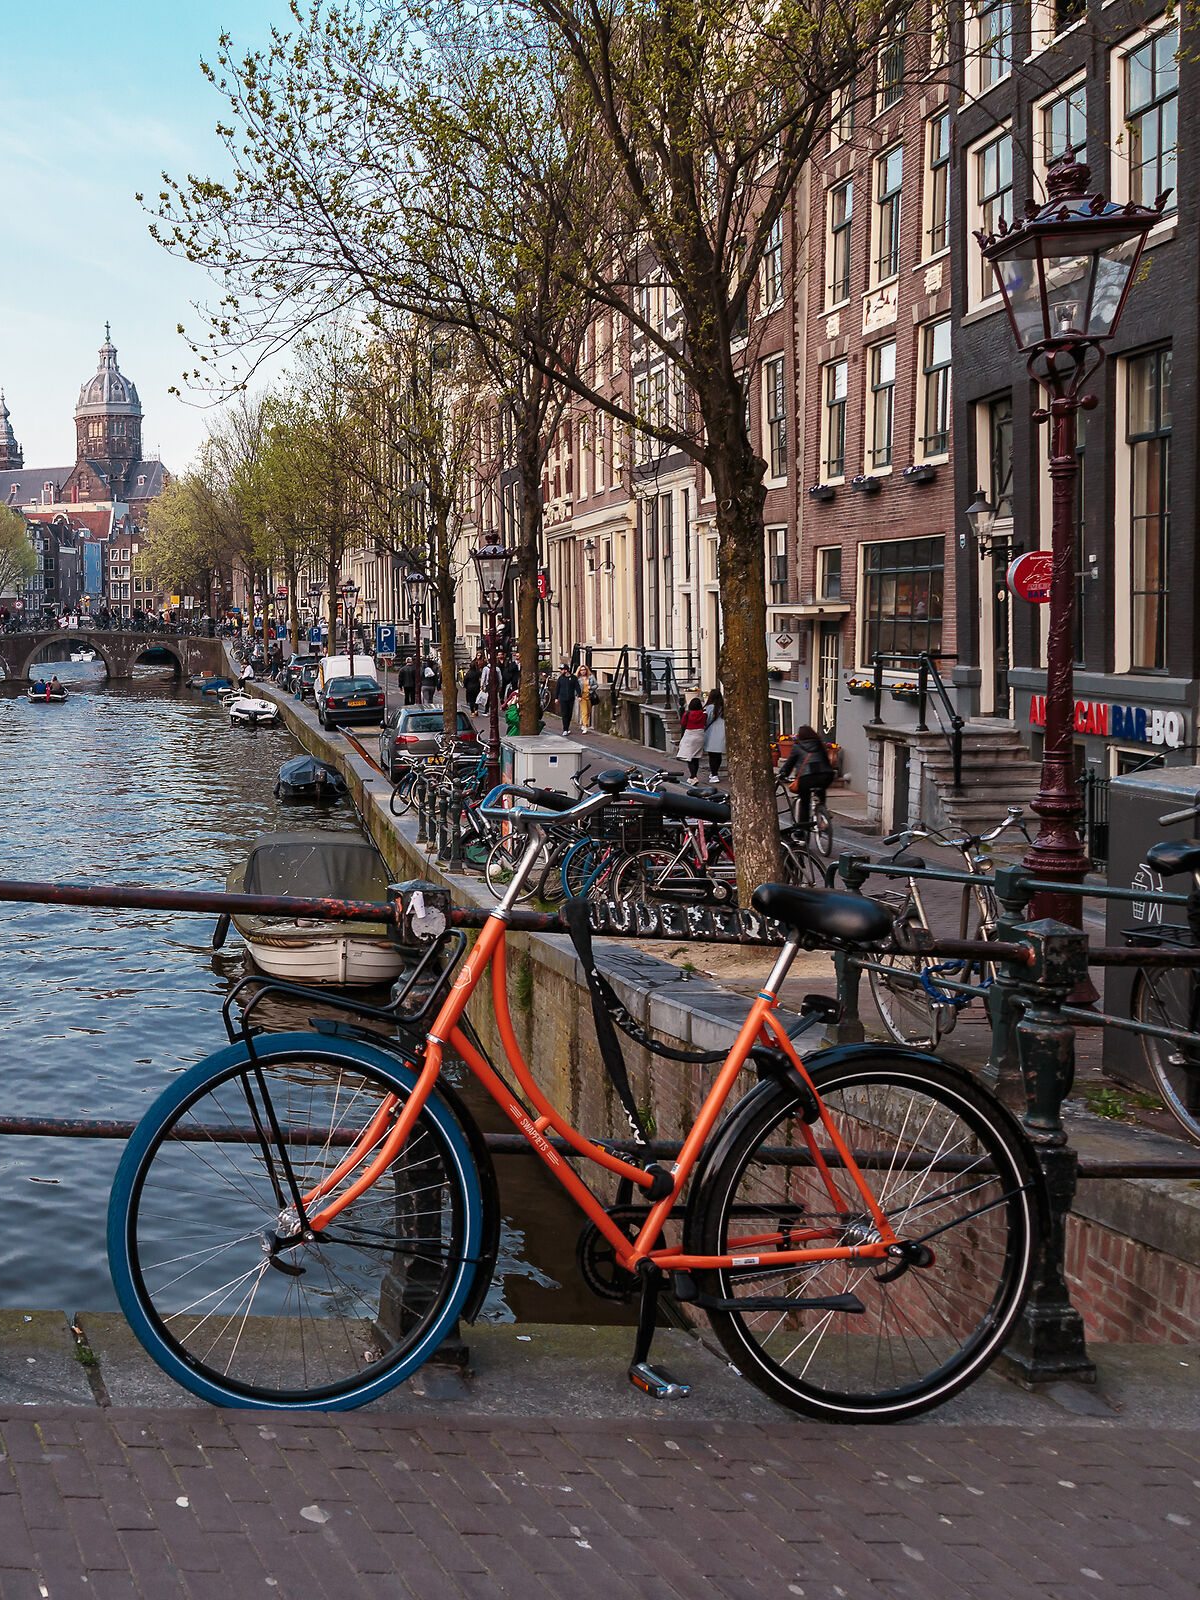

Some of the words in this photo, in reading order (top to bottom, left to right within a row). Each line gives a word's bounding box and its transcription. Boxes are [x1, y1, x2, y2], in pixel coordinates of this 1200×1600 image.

[381, 628, 391, 642] P
[1112, 704, 1183, 748] BAR-BQ
[520, 1118, 549, 1151] SWAPFIETS
